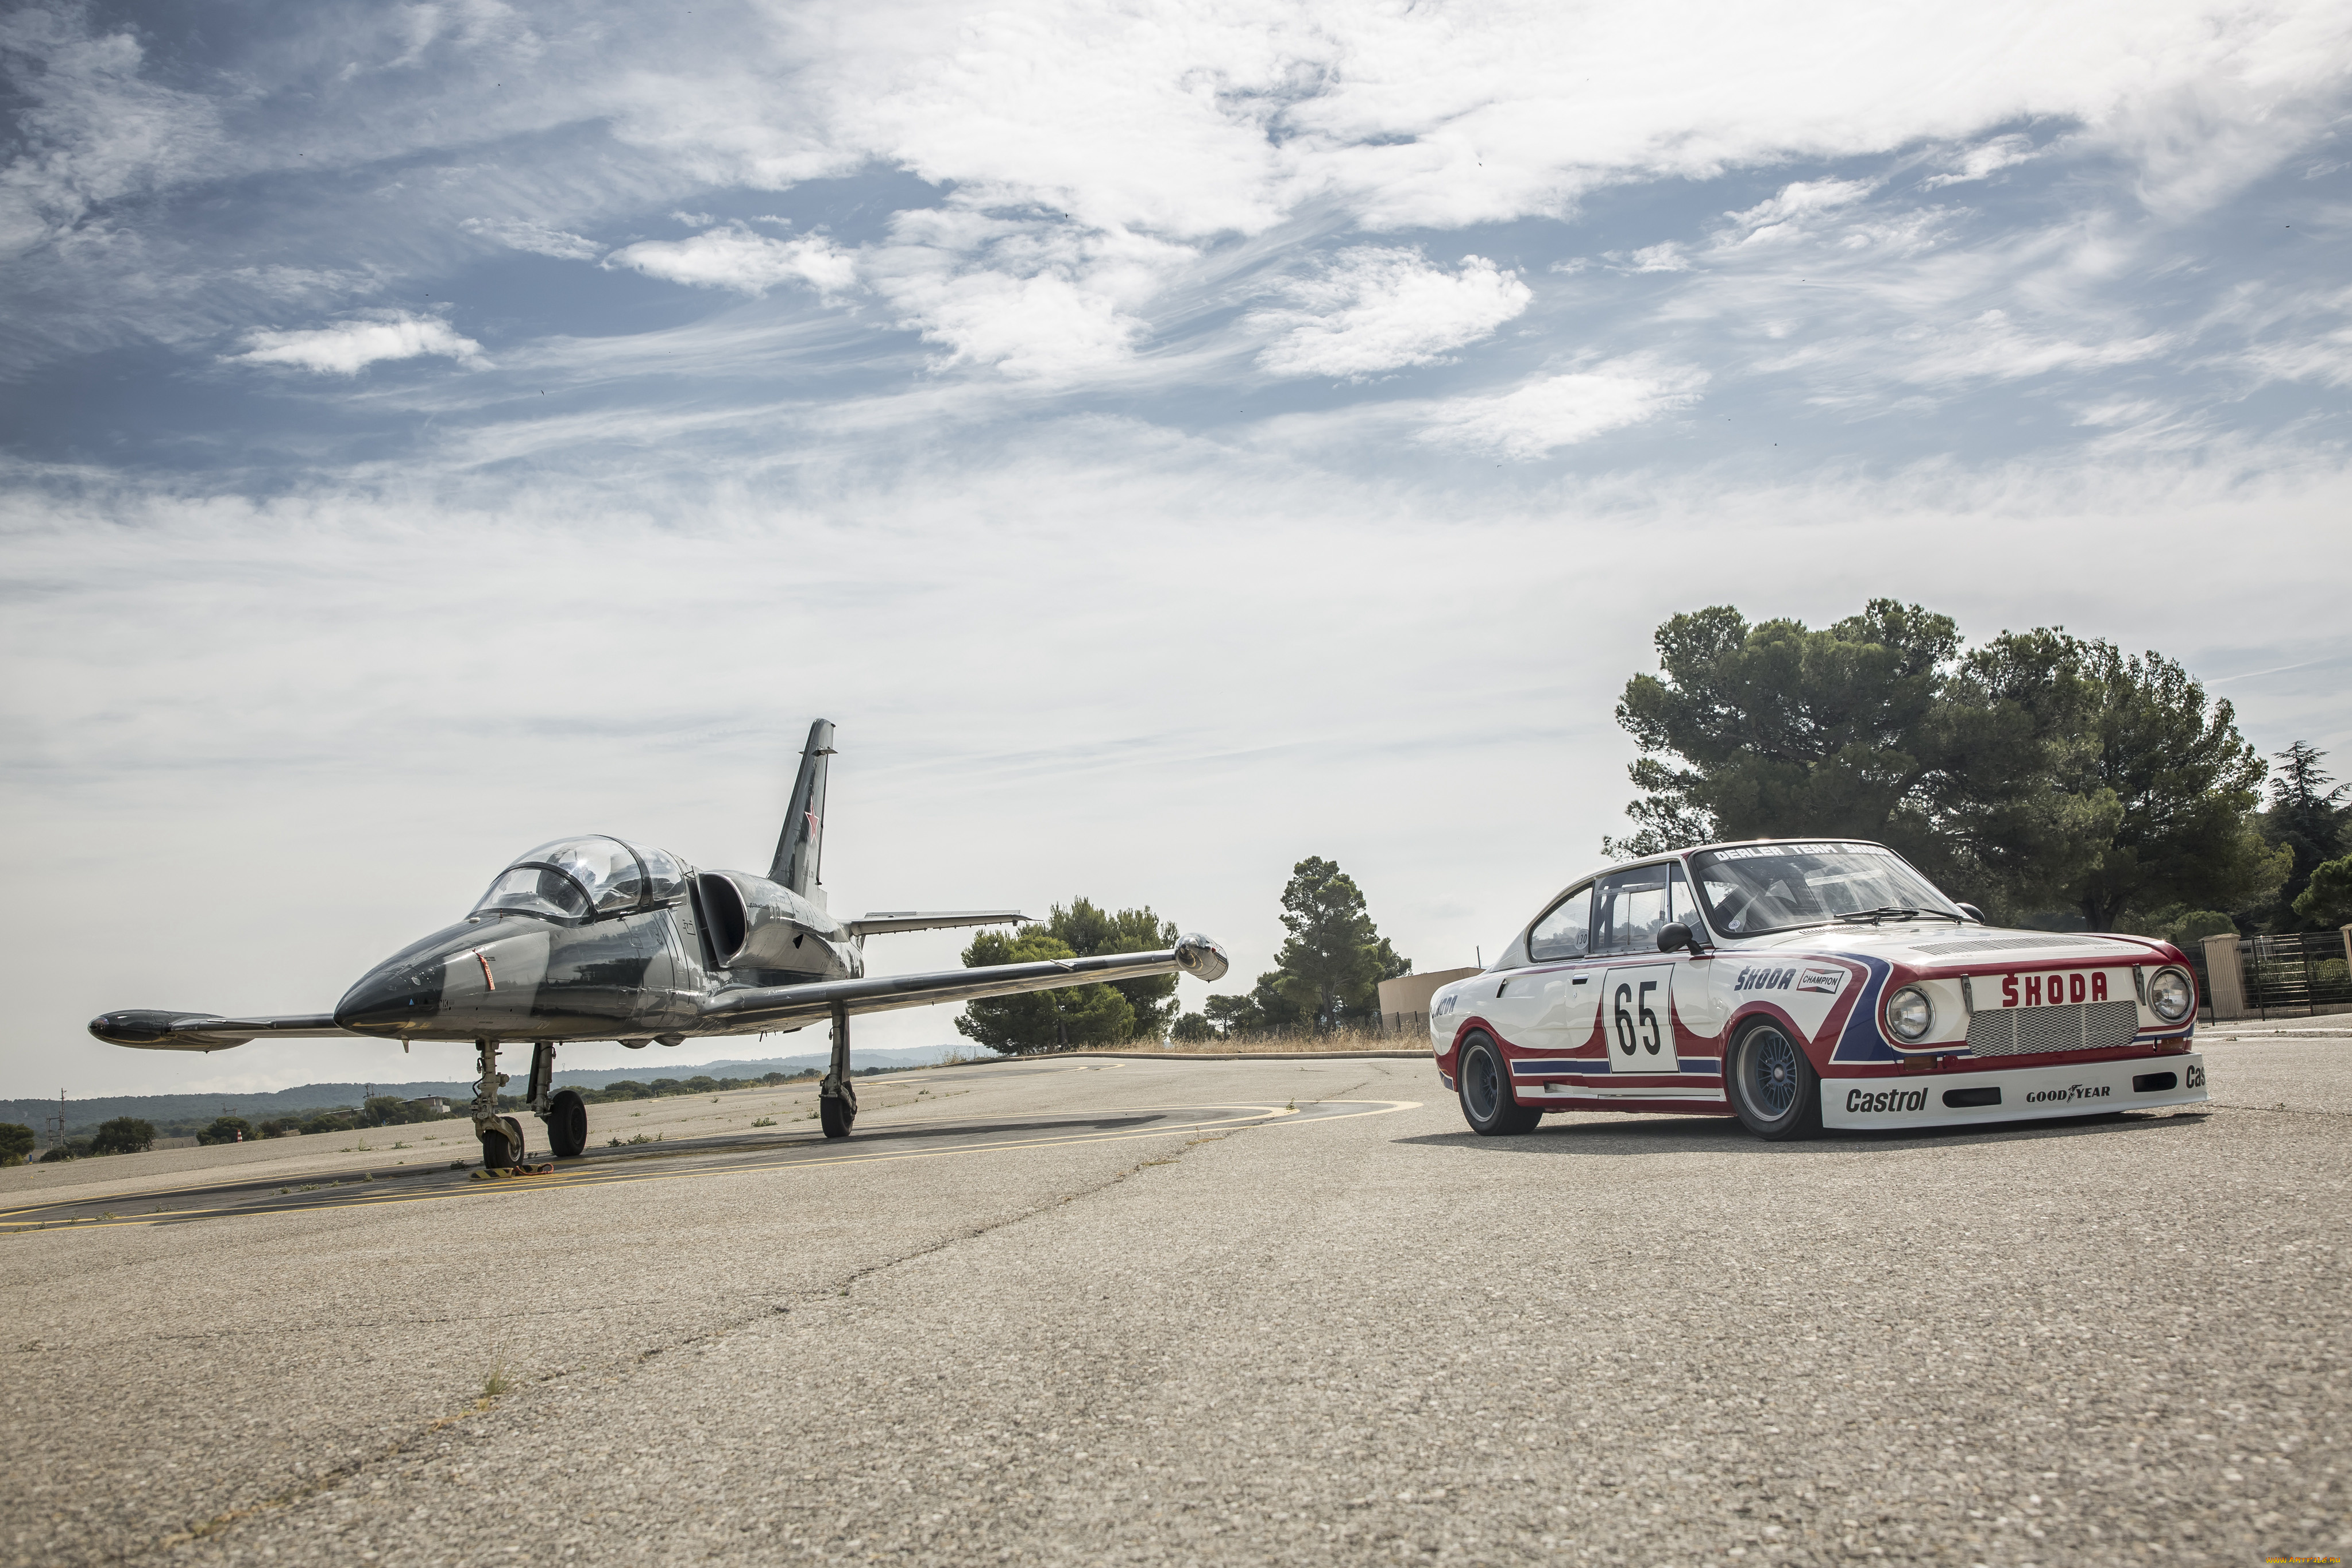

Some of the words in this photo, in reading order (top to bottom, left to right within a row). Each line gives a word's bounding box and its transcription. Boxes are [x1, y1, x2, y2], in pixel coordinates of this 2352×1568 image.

[1713, 846, 1785, 861] DEALER
[1788, 844, 1838, 854] TEAM
[1576, 934, 1587, 945] 130
[1734, 965, 1797, 991] ŠKODA
[1802, 975, 1838, 986] CHAMPION
[2002, 971, 2107, 1008] ŠKODA
[1615, 981, 1661, 1056] 65
[1846, 1087, 1929, 1113] Castrol
